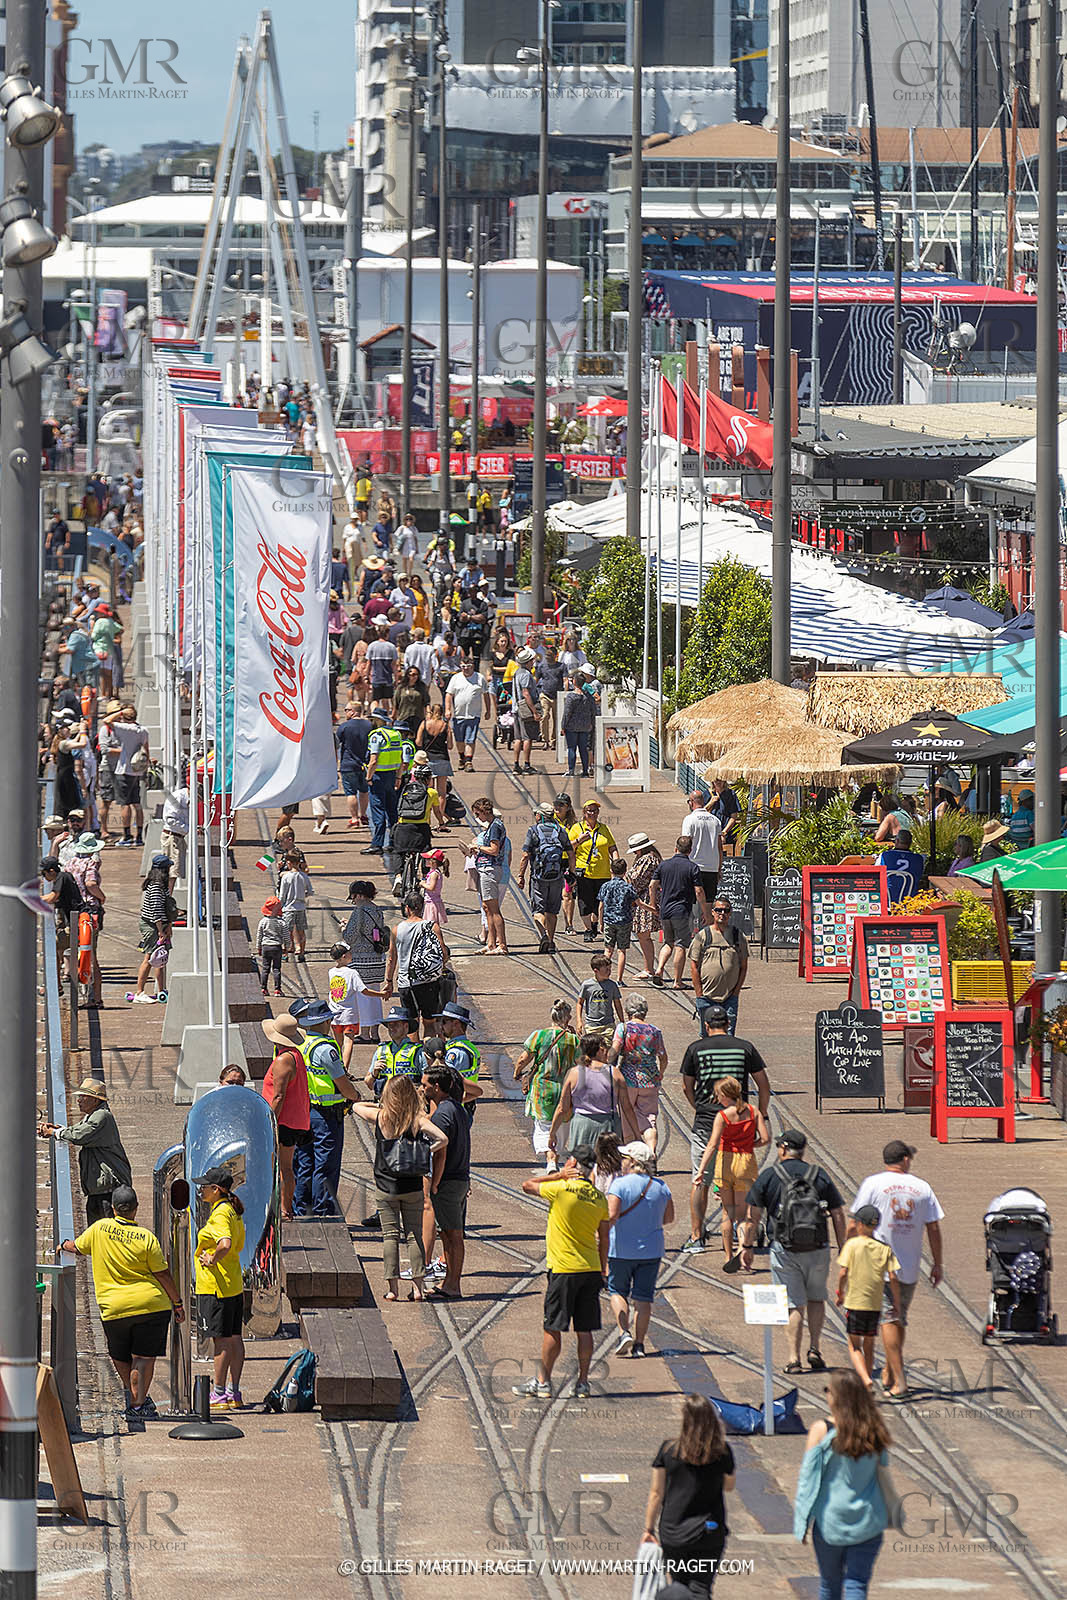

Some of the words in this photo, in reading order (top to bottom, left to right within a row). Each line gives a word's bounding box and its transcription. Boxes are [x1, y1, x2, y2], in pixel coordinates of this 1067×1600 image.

[256, 528, 307, 743] Coca-Cola
[891, 738, 964, 747] SAPPORO
[894, 751, 959, 762] サッポロビール
[824, 1040, 853, 1056] WATCH
[837, 1068, 861, 1085] RACE
[100, 1223, 126, 1237] VILLAGE
[126, 1228, 146, 1241] TEAM
